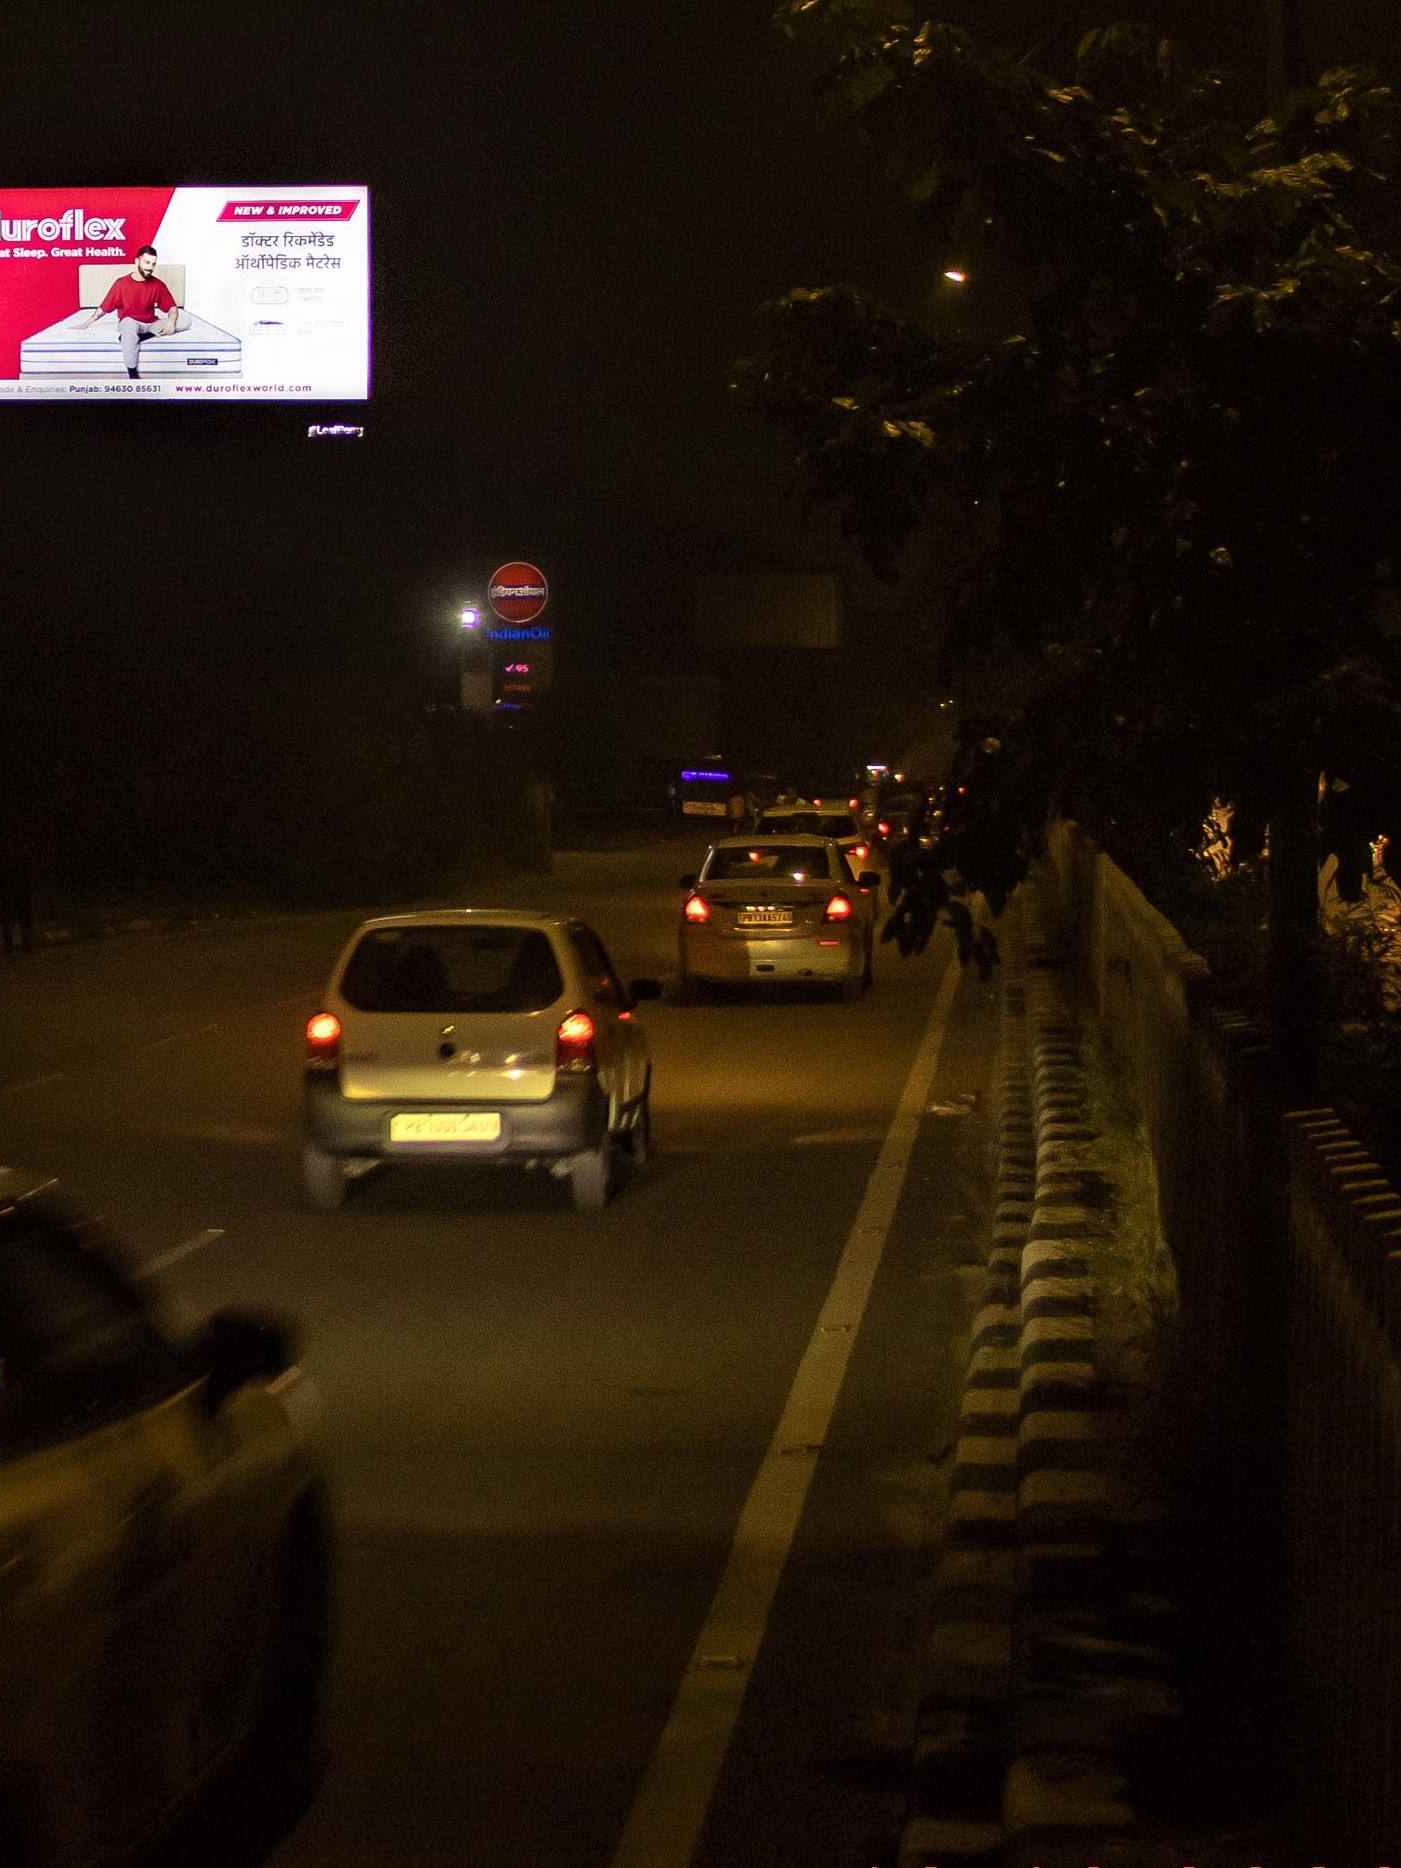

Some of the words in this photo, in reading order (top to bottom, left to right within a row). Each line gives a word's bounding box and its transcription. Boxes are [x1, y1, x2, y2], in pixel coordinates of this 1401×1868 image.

[234, 206, 264, 215] NEW
[267, 206, 275, 215] &
[278, 205, 342, 215] IMPROVED
[241, 232, 279, 247] डॉक्टर
[284, 231, 335, 247] रिकमेंडेड
[13, 247, 48, 259] Sleep.
[51, 247, 83, 257] Great
[86, 246, 126, 257] Health.
[234, 253, 301, 269] ऑर्थोपेडिक
[305, 253, 342, 269] मैटरेस
[69, 385, 102, 394] Punjab:
[104, 385, 133, 393] 94630
[175, 384, 312, 393] www.duroflexworld.com
